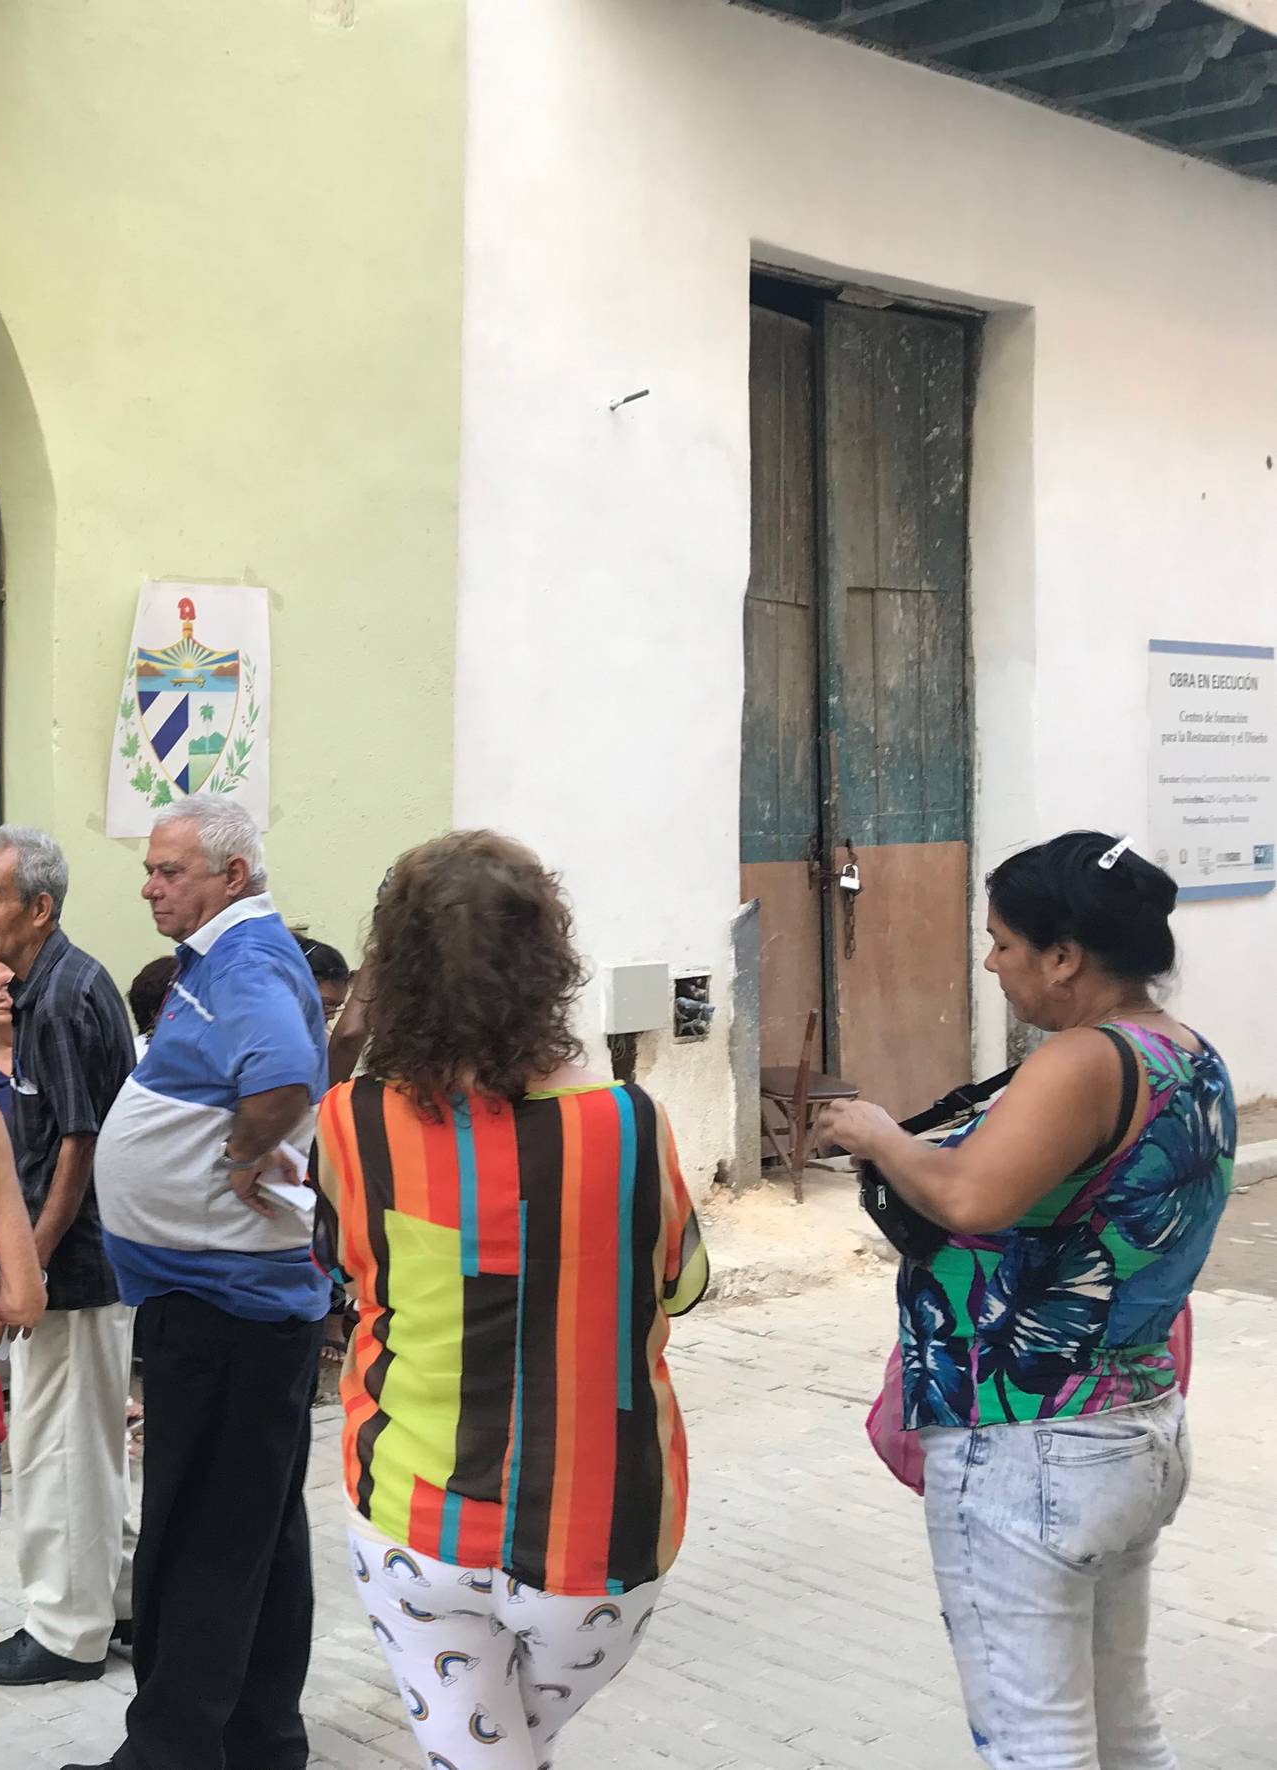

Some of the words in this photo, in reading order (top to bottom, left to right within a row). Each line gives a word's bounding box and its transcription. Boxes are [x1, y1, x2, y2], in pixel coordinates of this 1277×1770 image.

[1169, 672, 1196, 688] OBRA
[1197, 673, 1210, 689] EN
[1211, 672, 1259, 691] EJECUCIÓN
[1178, 710, 1204, 723] Centro
[1204, 711, 1213, 723] de
[1161, 733, 1177, 746] para
[1177, 731, 1185, 742] la
[1186, 730, 1230, 743] Restauración
